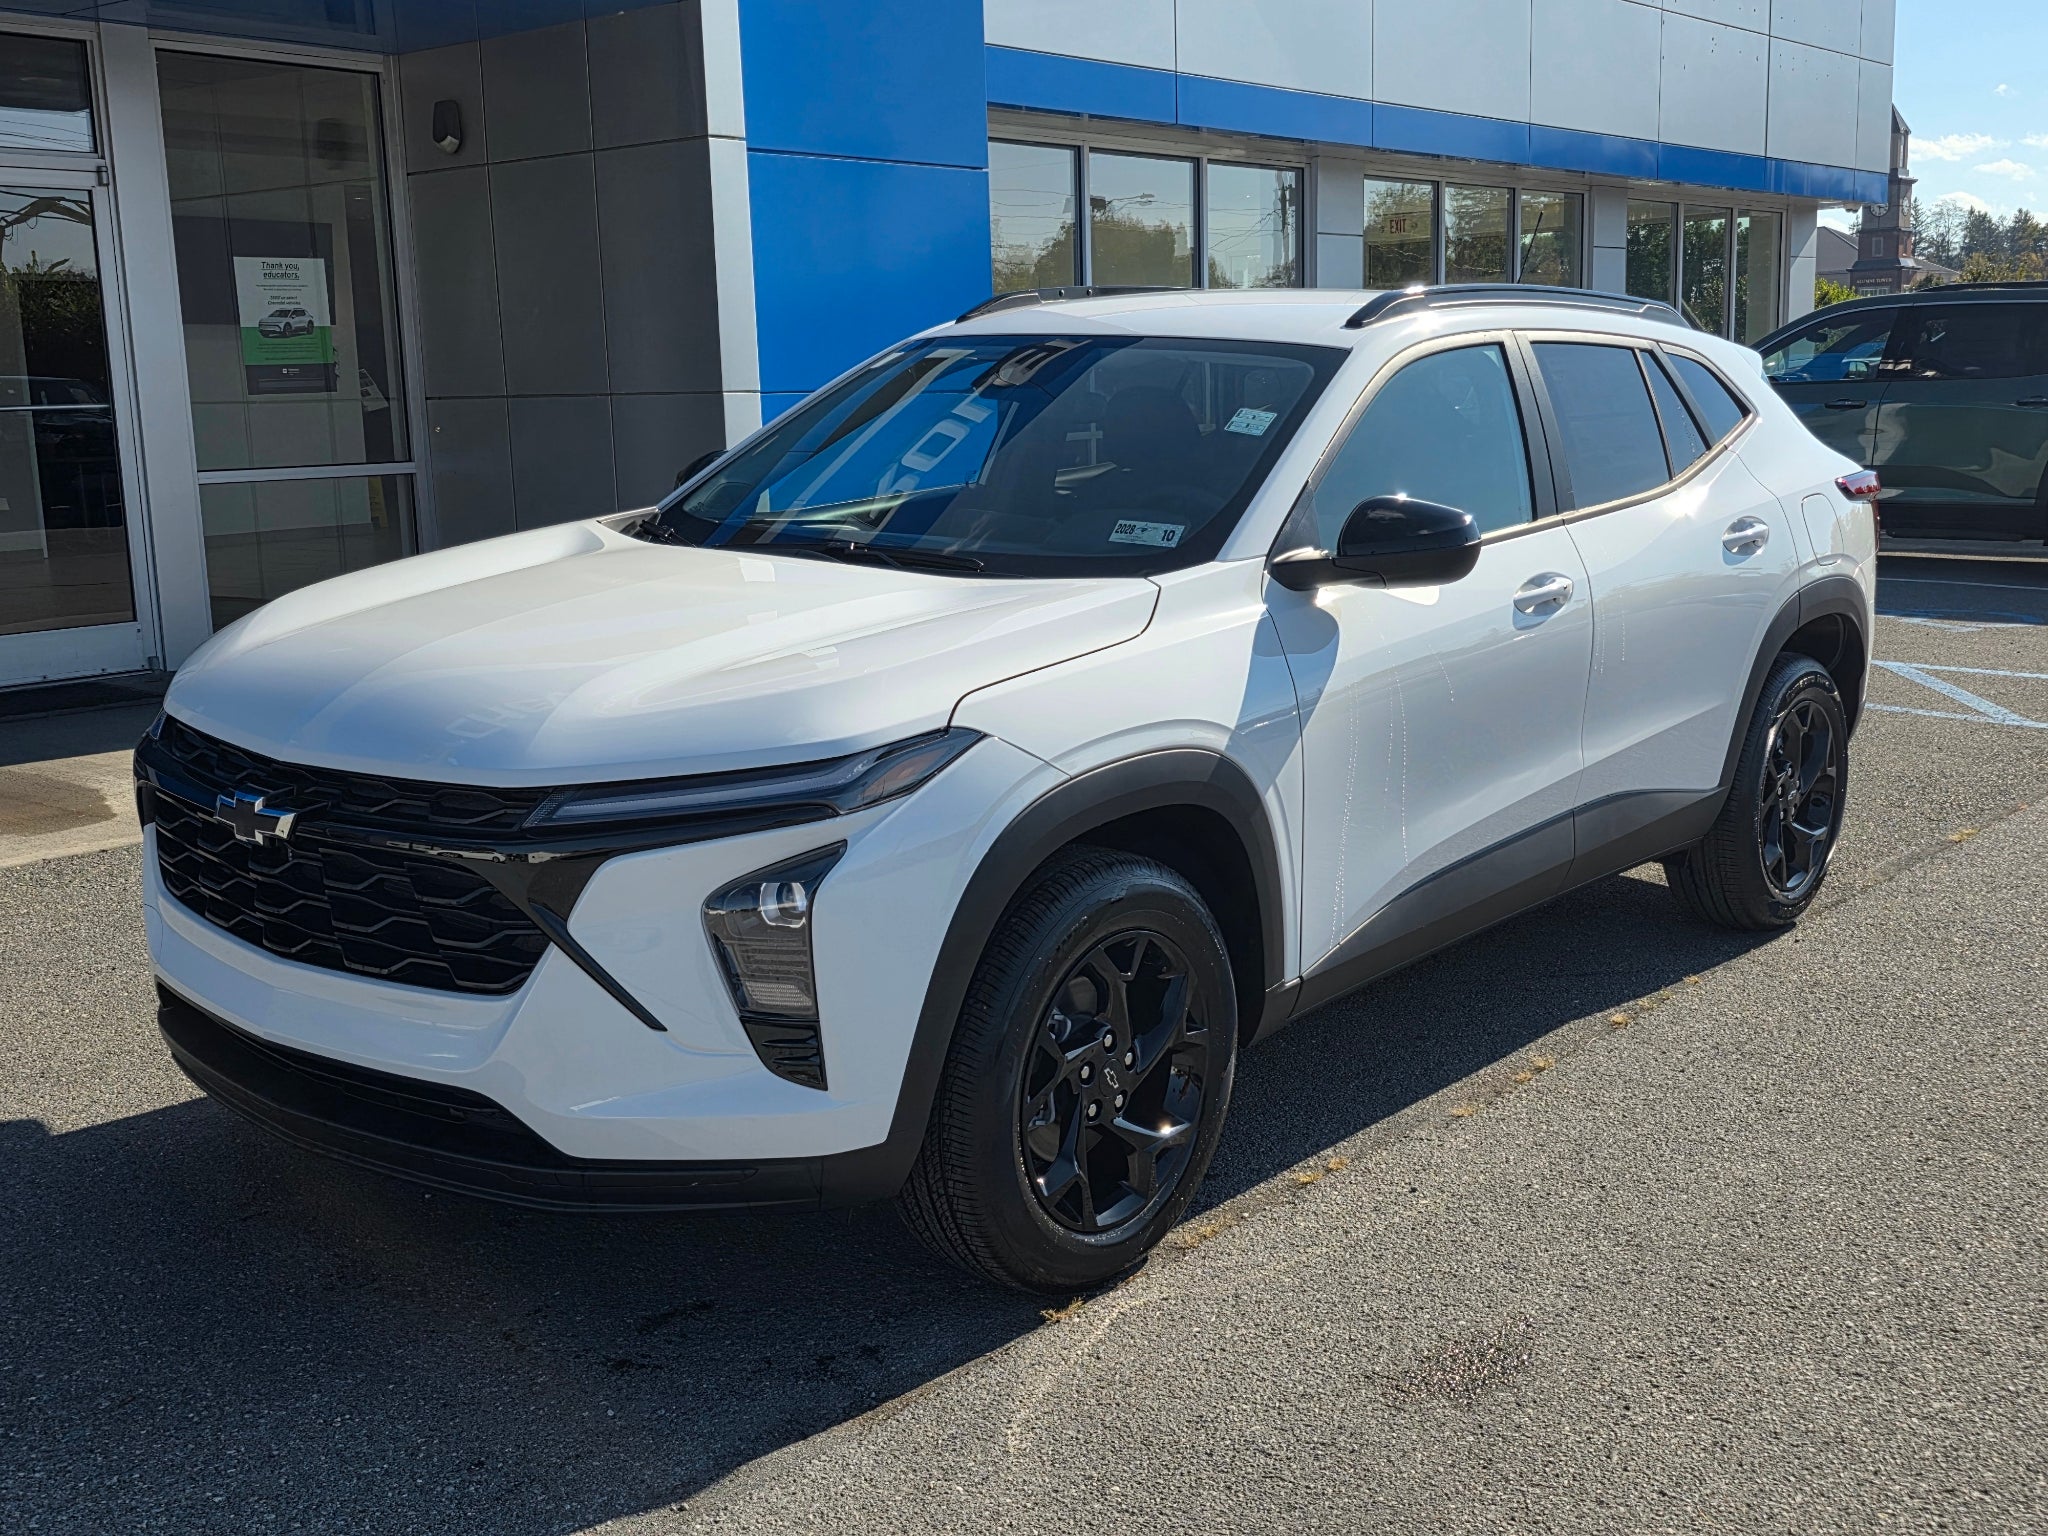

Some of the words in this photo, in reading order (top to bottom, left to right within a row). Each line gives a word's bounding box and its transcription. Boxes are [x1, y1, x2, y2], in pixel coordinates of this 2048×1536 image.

[1389, 218, 1407, 234] EXIT
[261, 261, 283, 270] Thank
[284, 263, 300, 271] you,
[263, 270, 300, 279] educators.
[1115, 523, 1137, 534] 2028
[1161, 529, 1176, 542] 10
